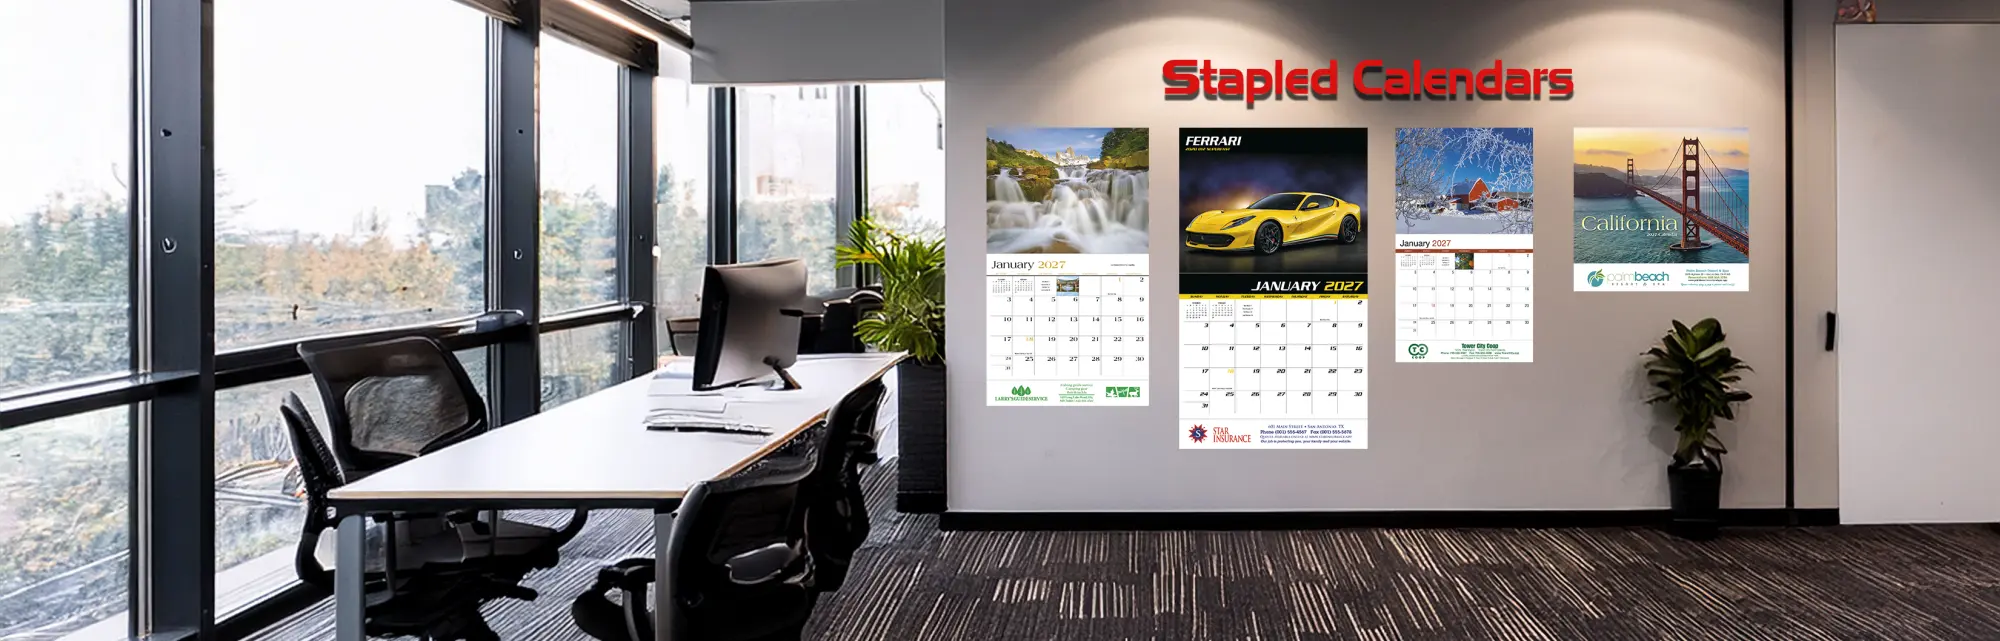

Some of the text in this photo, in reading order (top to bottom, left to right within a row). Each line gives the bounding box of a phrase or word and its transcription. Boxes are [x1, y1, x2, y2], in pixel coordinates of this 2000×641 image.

[1185, 136, 1242, 146] FERRARI
[1581, 215, 1678, 231] California
[1400, 240, 1430, 248] January
[991, 260, 1066, 271] January 2027
[1251, 281, 1364, 291] JANUARY 2027
[1213, 427, 1229, 435] STAR
[1213, 434, 1251, 443] INSURANCE
